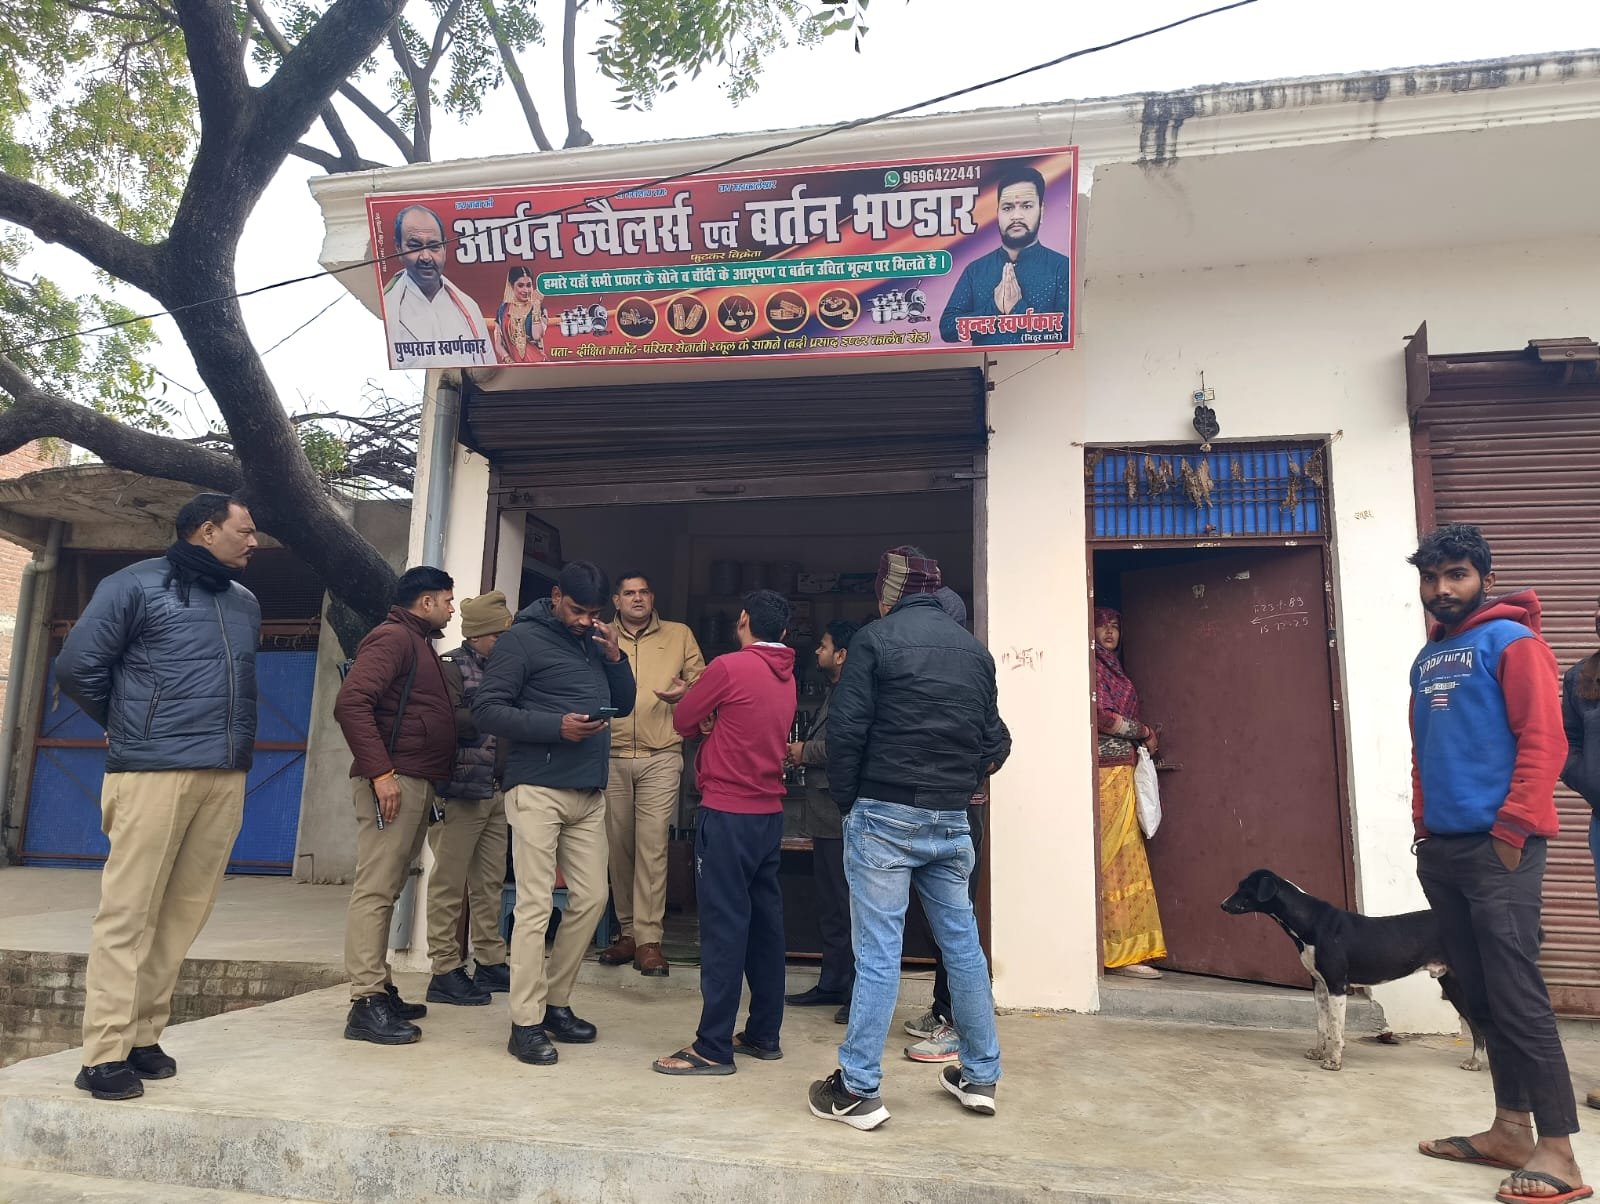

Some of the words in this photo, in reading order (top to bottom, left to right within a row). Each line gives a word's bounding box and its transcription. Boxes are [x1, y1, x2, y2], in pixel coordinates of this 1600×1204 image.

[903, 165, 981, 184] 9696422441
[453, 200, 564, 264] आर्यन
[567, 191, 693, 256] ज्वैलर्स
[700, 211, 740, 249] एवं
[744, 183, 841, 247] बर्तन
[852, 186, 979, 240] भण्डार
[543, 274, 567, 290] हमारे
[614, 273, 641, 287] प्रकार
[643, 270, 655, 285] के
[657, 269, 679, 284] सोने
[681, 271, 690, 284] व
[718, 266, 729, 281] के
[777, 266, 787, 278] व
[789, 261, 814, 277] बर्तन
[816, 260, 845, 276] उचित
[847, 261, 873, 278] मूल्य
[875, 260, 890, 273] पर
[892, 255, 926, 272] मिलते
[956, 316, 996, 342] सुन्दर
[997, 308, 1065, 334] स्वर्णकार
[394, 341, 435, 362] पुष्पराज
[437, 335, 487, 356] स्वर्णकार
[576, 342, 606, 358] दीक्षित
[709, 341, 736, 355] स्कूल
[738, 337, 750, 351] के
[752, 335, 781, 351] सामने
[809, 336, 839, 349] प्रसाद
